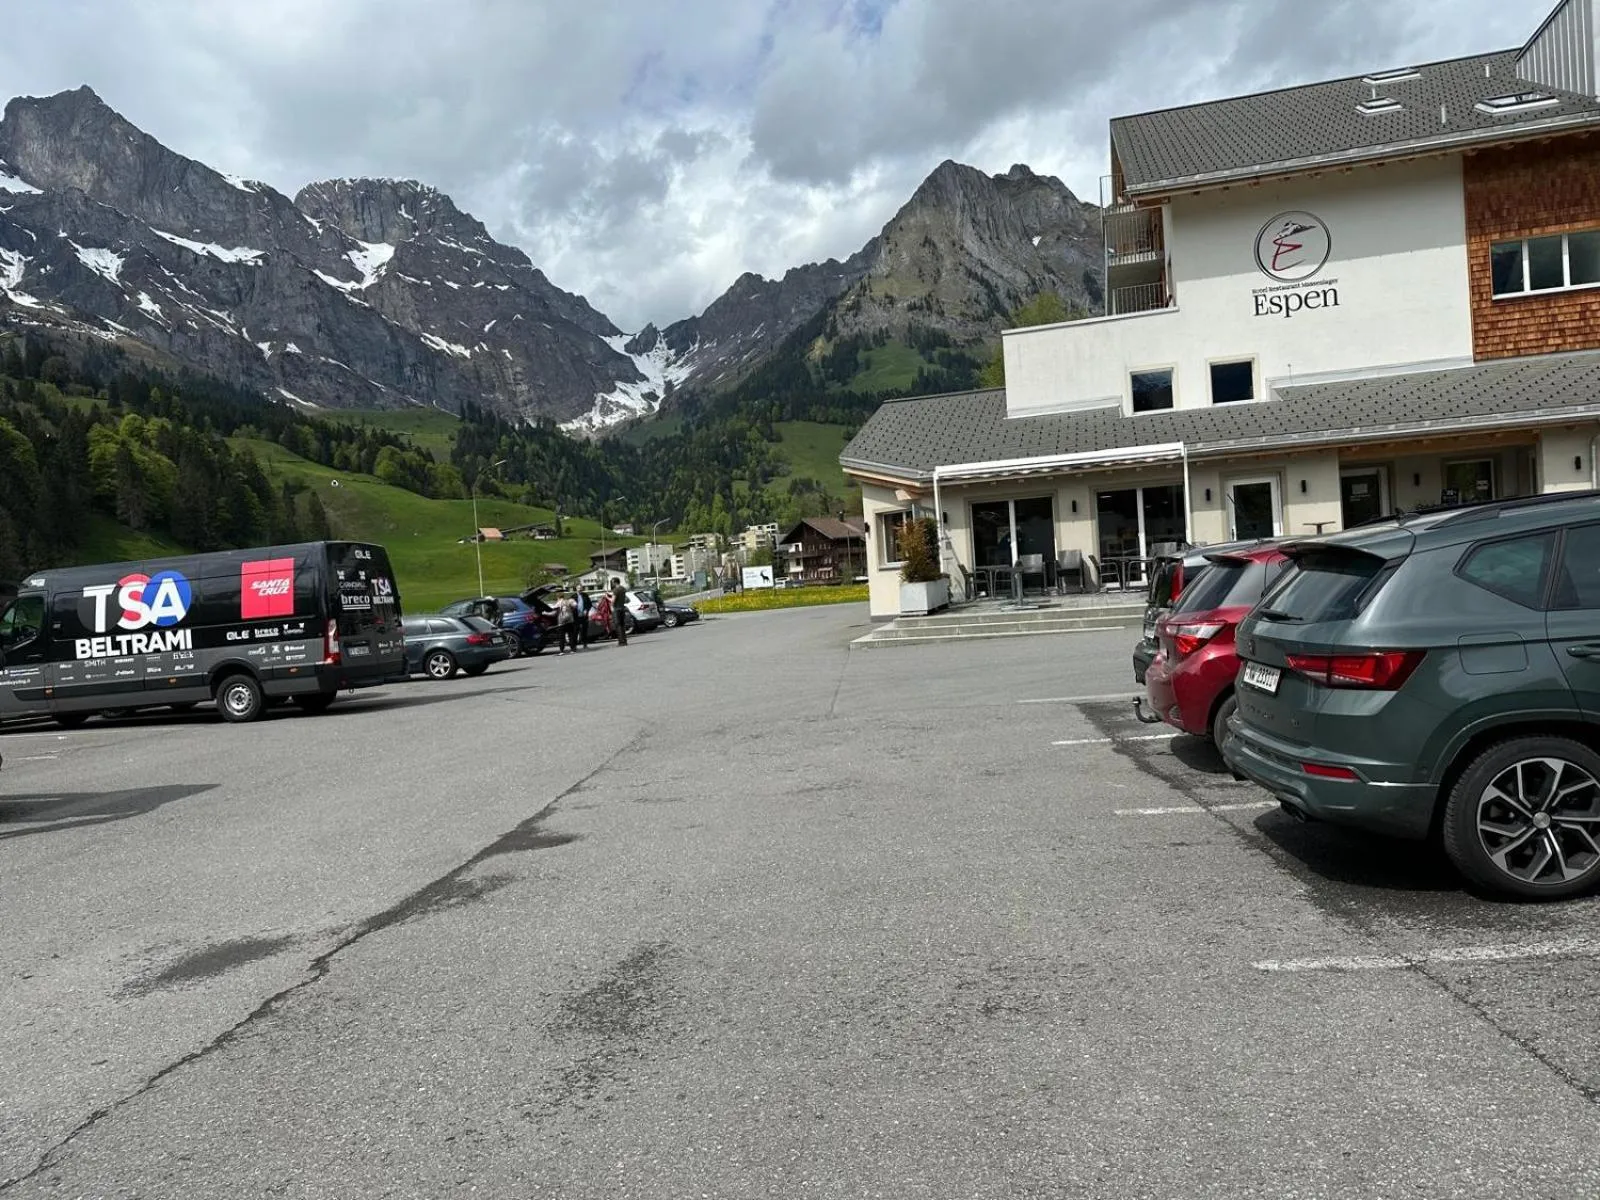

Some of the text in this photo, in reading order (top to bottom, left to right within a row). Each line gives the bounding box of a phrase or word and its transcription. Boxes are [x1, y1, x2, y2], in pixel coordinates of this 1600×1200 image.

[1269, 283, 1301, 292] Restaurant
[1253, 288, 1340, 318] Espen
[251, 577, 290, 589] SANTA
[371, 577, 392, 596] TSA
[258, 586, 289, 597] CRUZ
[83, 577, 187, 633] TSA
[341, 594, 370, 605] breco
[76, 629, 192, 659] BELTRAMI
[84, 659, 106, 668] SMITH
